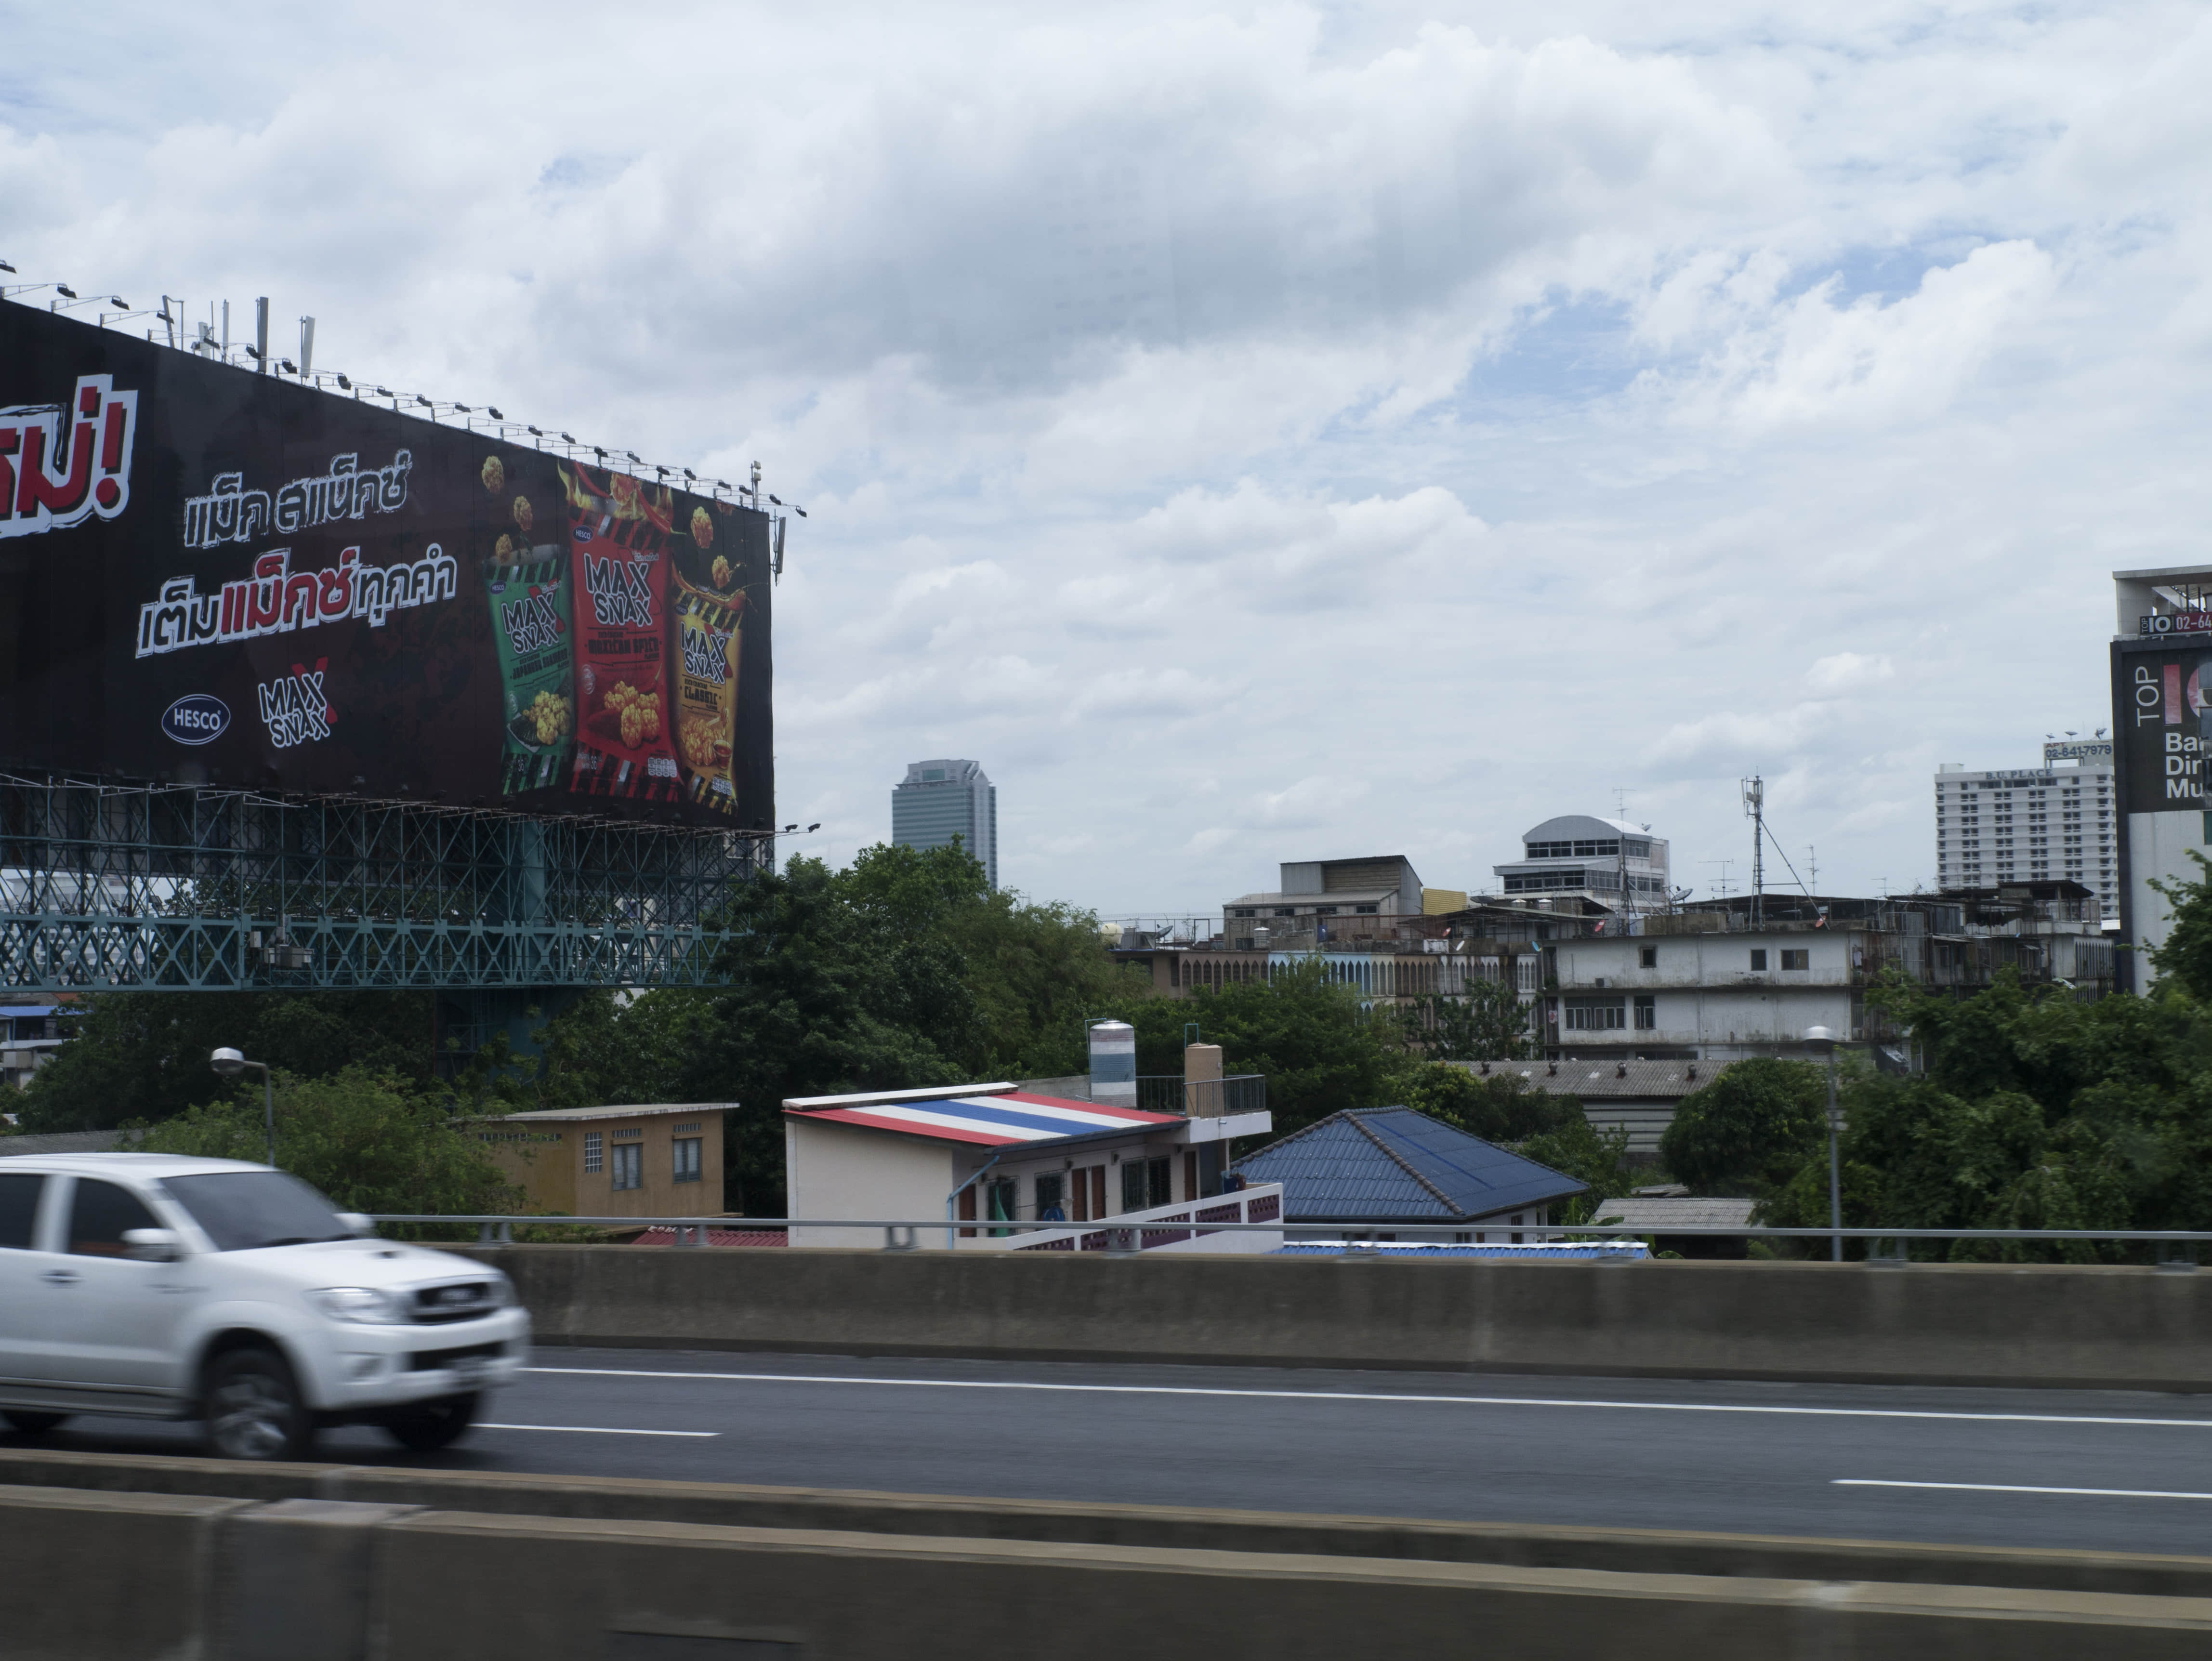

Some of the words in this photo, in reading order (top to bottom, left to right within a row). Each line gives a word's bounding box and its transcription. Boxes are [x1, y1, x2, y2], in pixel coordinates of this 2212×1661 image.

[0, 375, 137, 537] ม่!
[576, 530, 591, 539] HESCO
[584, 553, 651, 598] MAX
[501, 592, 556, 634] MAX
[593, 592, 652, 627] SNAX
[2149, 616, 2171, 633] 10
[511, 620, 559, 654] SNAX
[681, 621, 726, 664] MAX
[684, 650, 725, 684] SNAX
[258, 672, 327, 723] MAX
[685, 686, 717, 705] CLASSIC
[2135, 666, 2159, 727] TOP
[174, 709, 221, 731] HESCO
[268, 711, 329, 748] SNAX
[591, 755, 597, 770] 36
[2046, 744, 2112, 758] 02-641-7979
[1986, 771, 2007, 779] B.U.
[2010, 768, 2053, 778] PLACE
